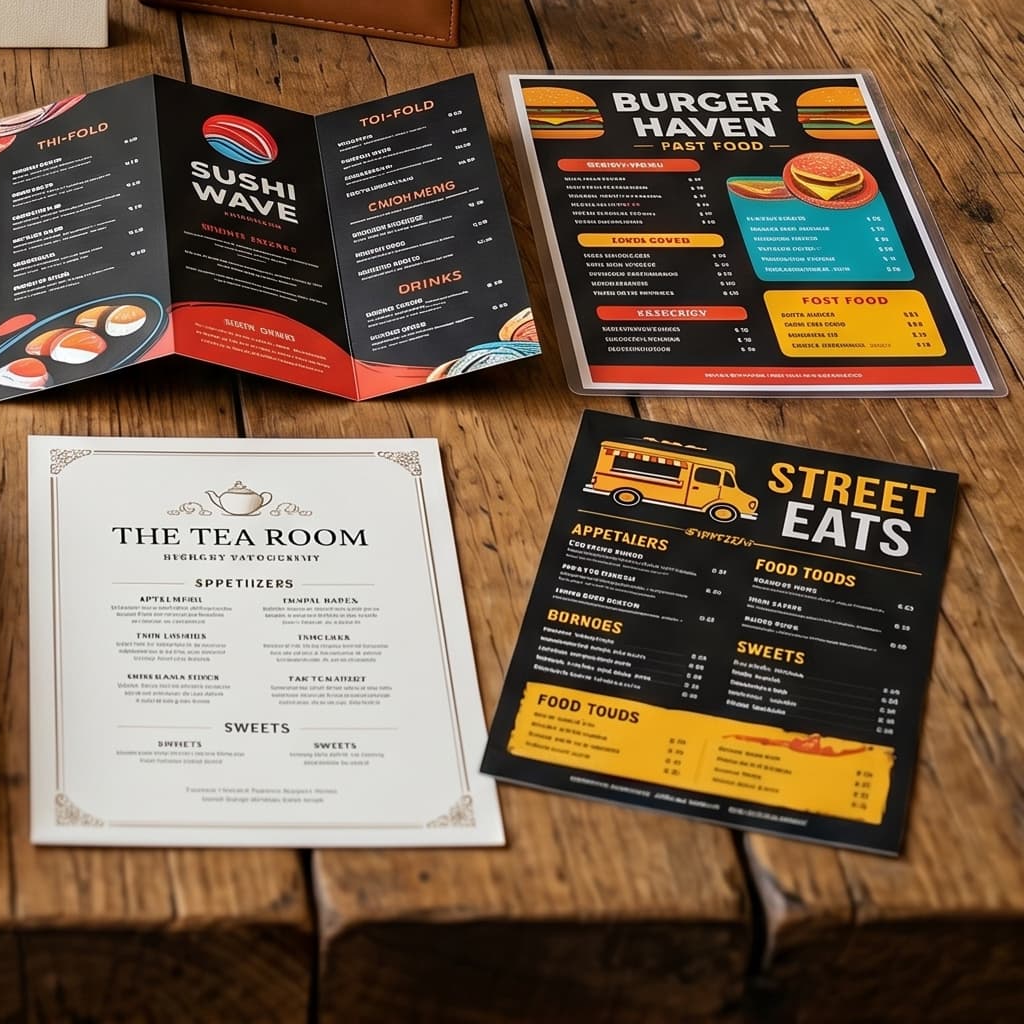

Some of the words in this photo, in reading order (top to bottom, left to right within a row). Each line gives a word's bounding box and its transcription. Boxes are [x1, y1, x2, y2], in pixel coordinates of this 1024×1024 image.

[612, 92, 782, 113] BURGER
[37, 122, 109, 150] THI-FOLD
[632, 117, 776, 137] HAVEN
[712, 141, 764, 151] FOOD
[190, 160, 296, 201] SUSHI
[191, 181, 299, 224] WAVE
[398, 270, 463, 295] DRINKS
[845, 297, 889, 305] FOOD
[767, 461, 936, 519] STREET
[112, 527, 181, 545] THE
[190, 528, 256, 546] TEA
[264, 528, 369, 546] ROOM
[781, 500, 912, 557] EATS
[755, 558, 798, 577] FOOD
[802, 567, 857, 588] TOODS
[736, 640, 806, 665] SWEETS
[537, 692, 582, 713] FOOD
[587, 703, 640, 724] TOUDS
[224, 722, 290, 734] SWEETS
